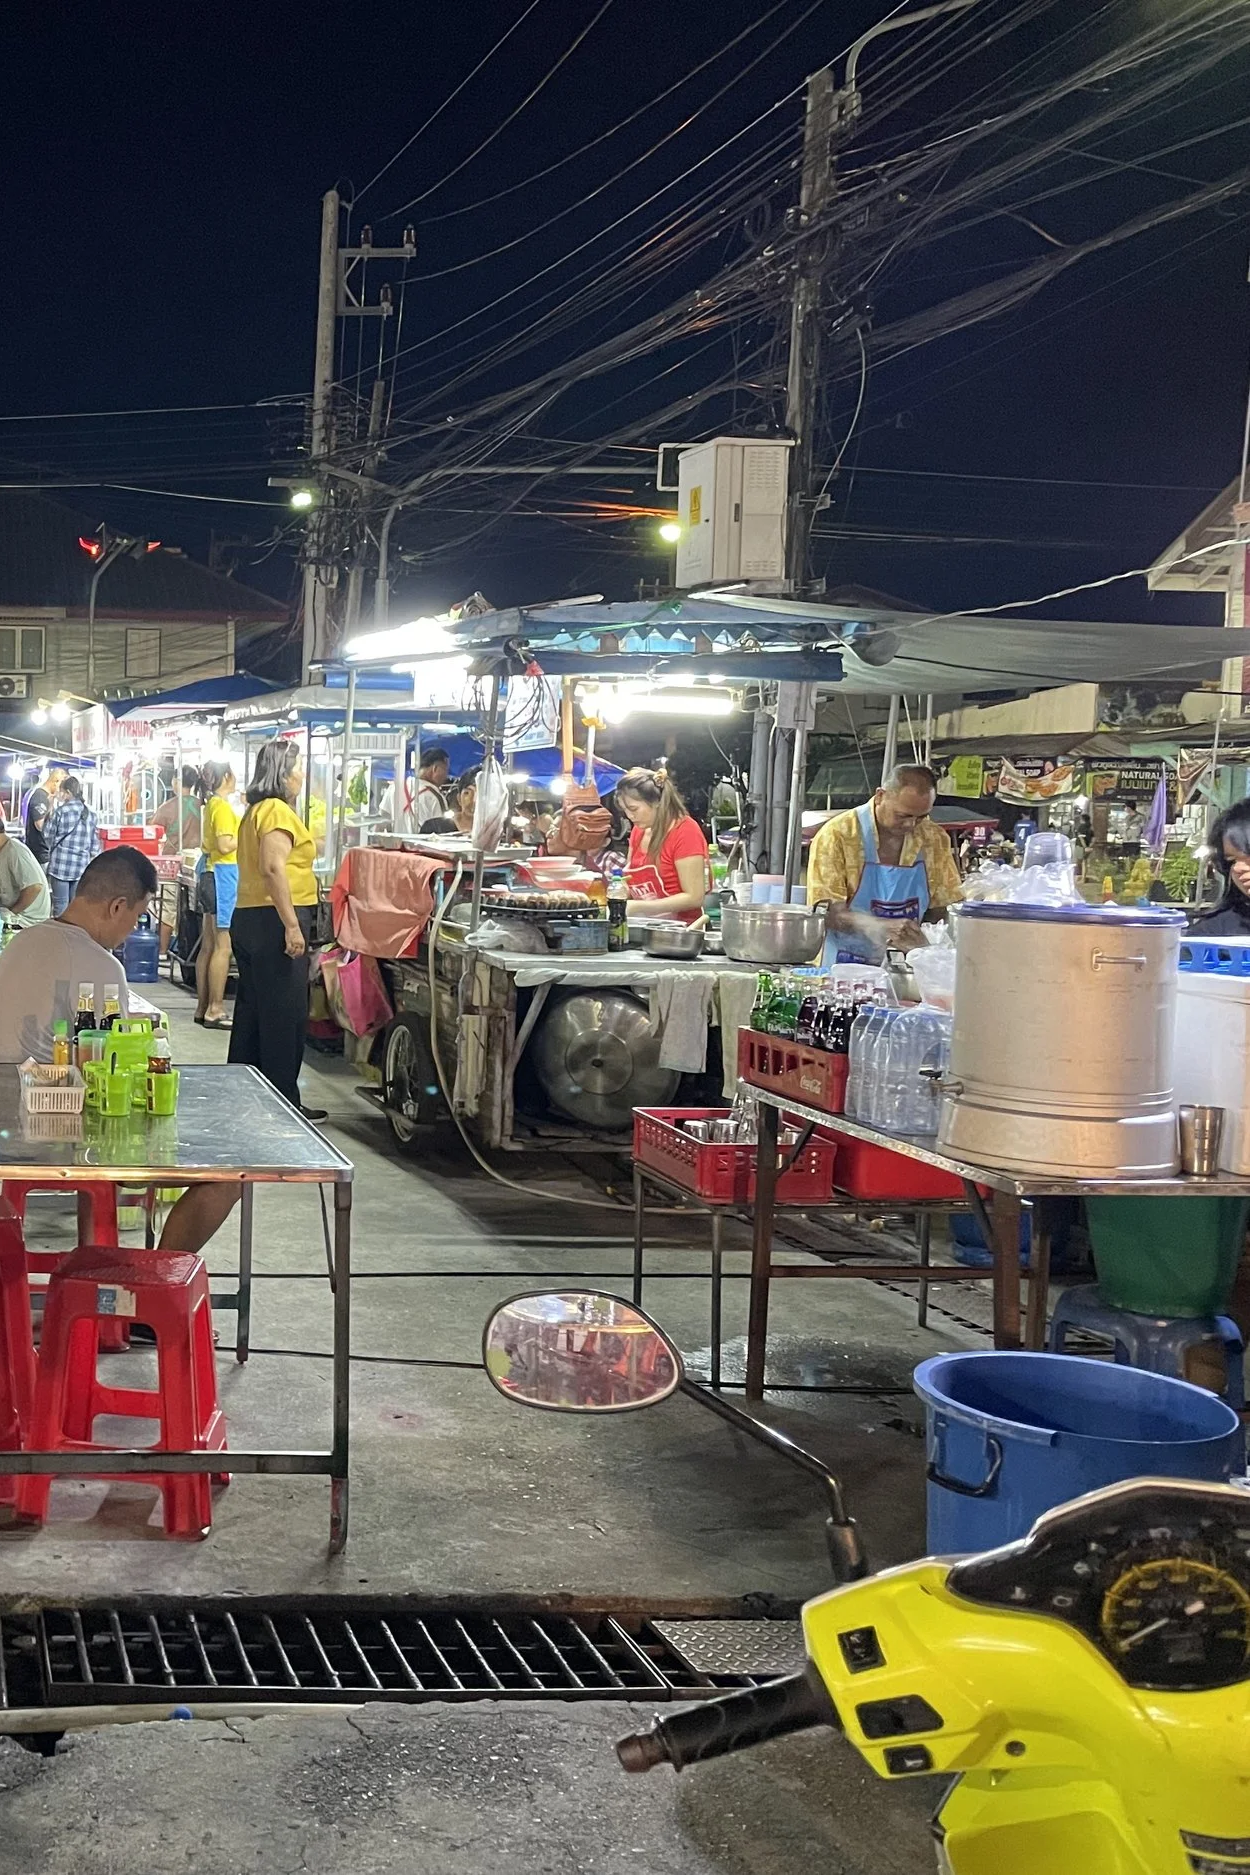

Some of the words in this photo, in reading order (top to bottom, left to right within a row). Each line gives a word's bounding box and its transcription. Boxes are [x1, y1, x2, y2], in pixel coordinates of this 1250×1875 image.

[1121, 772, 1163, 781] NATURAL
[1164, 772, 1178, 781] SO
[974, 826, 986, 837] 30
[1018, 827, 1026, 840] 4
